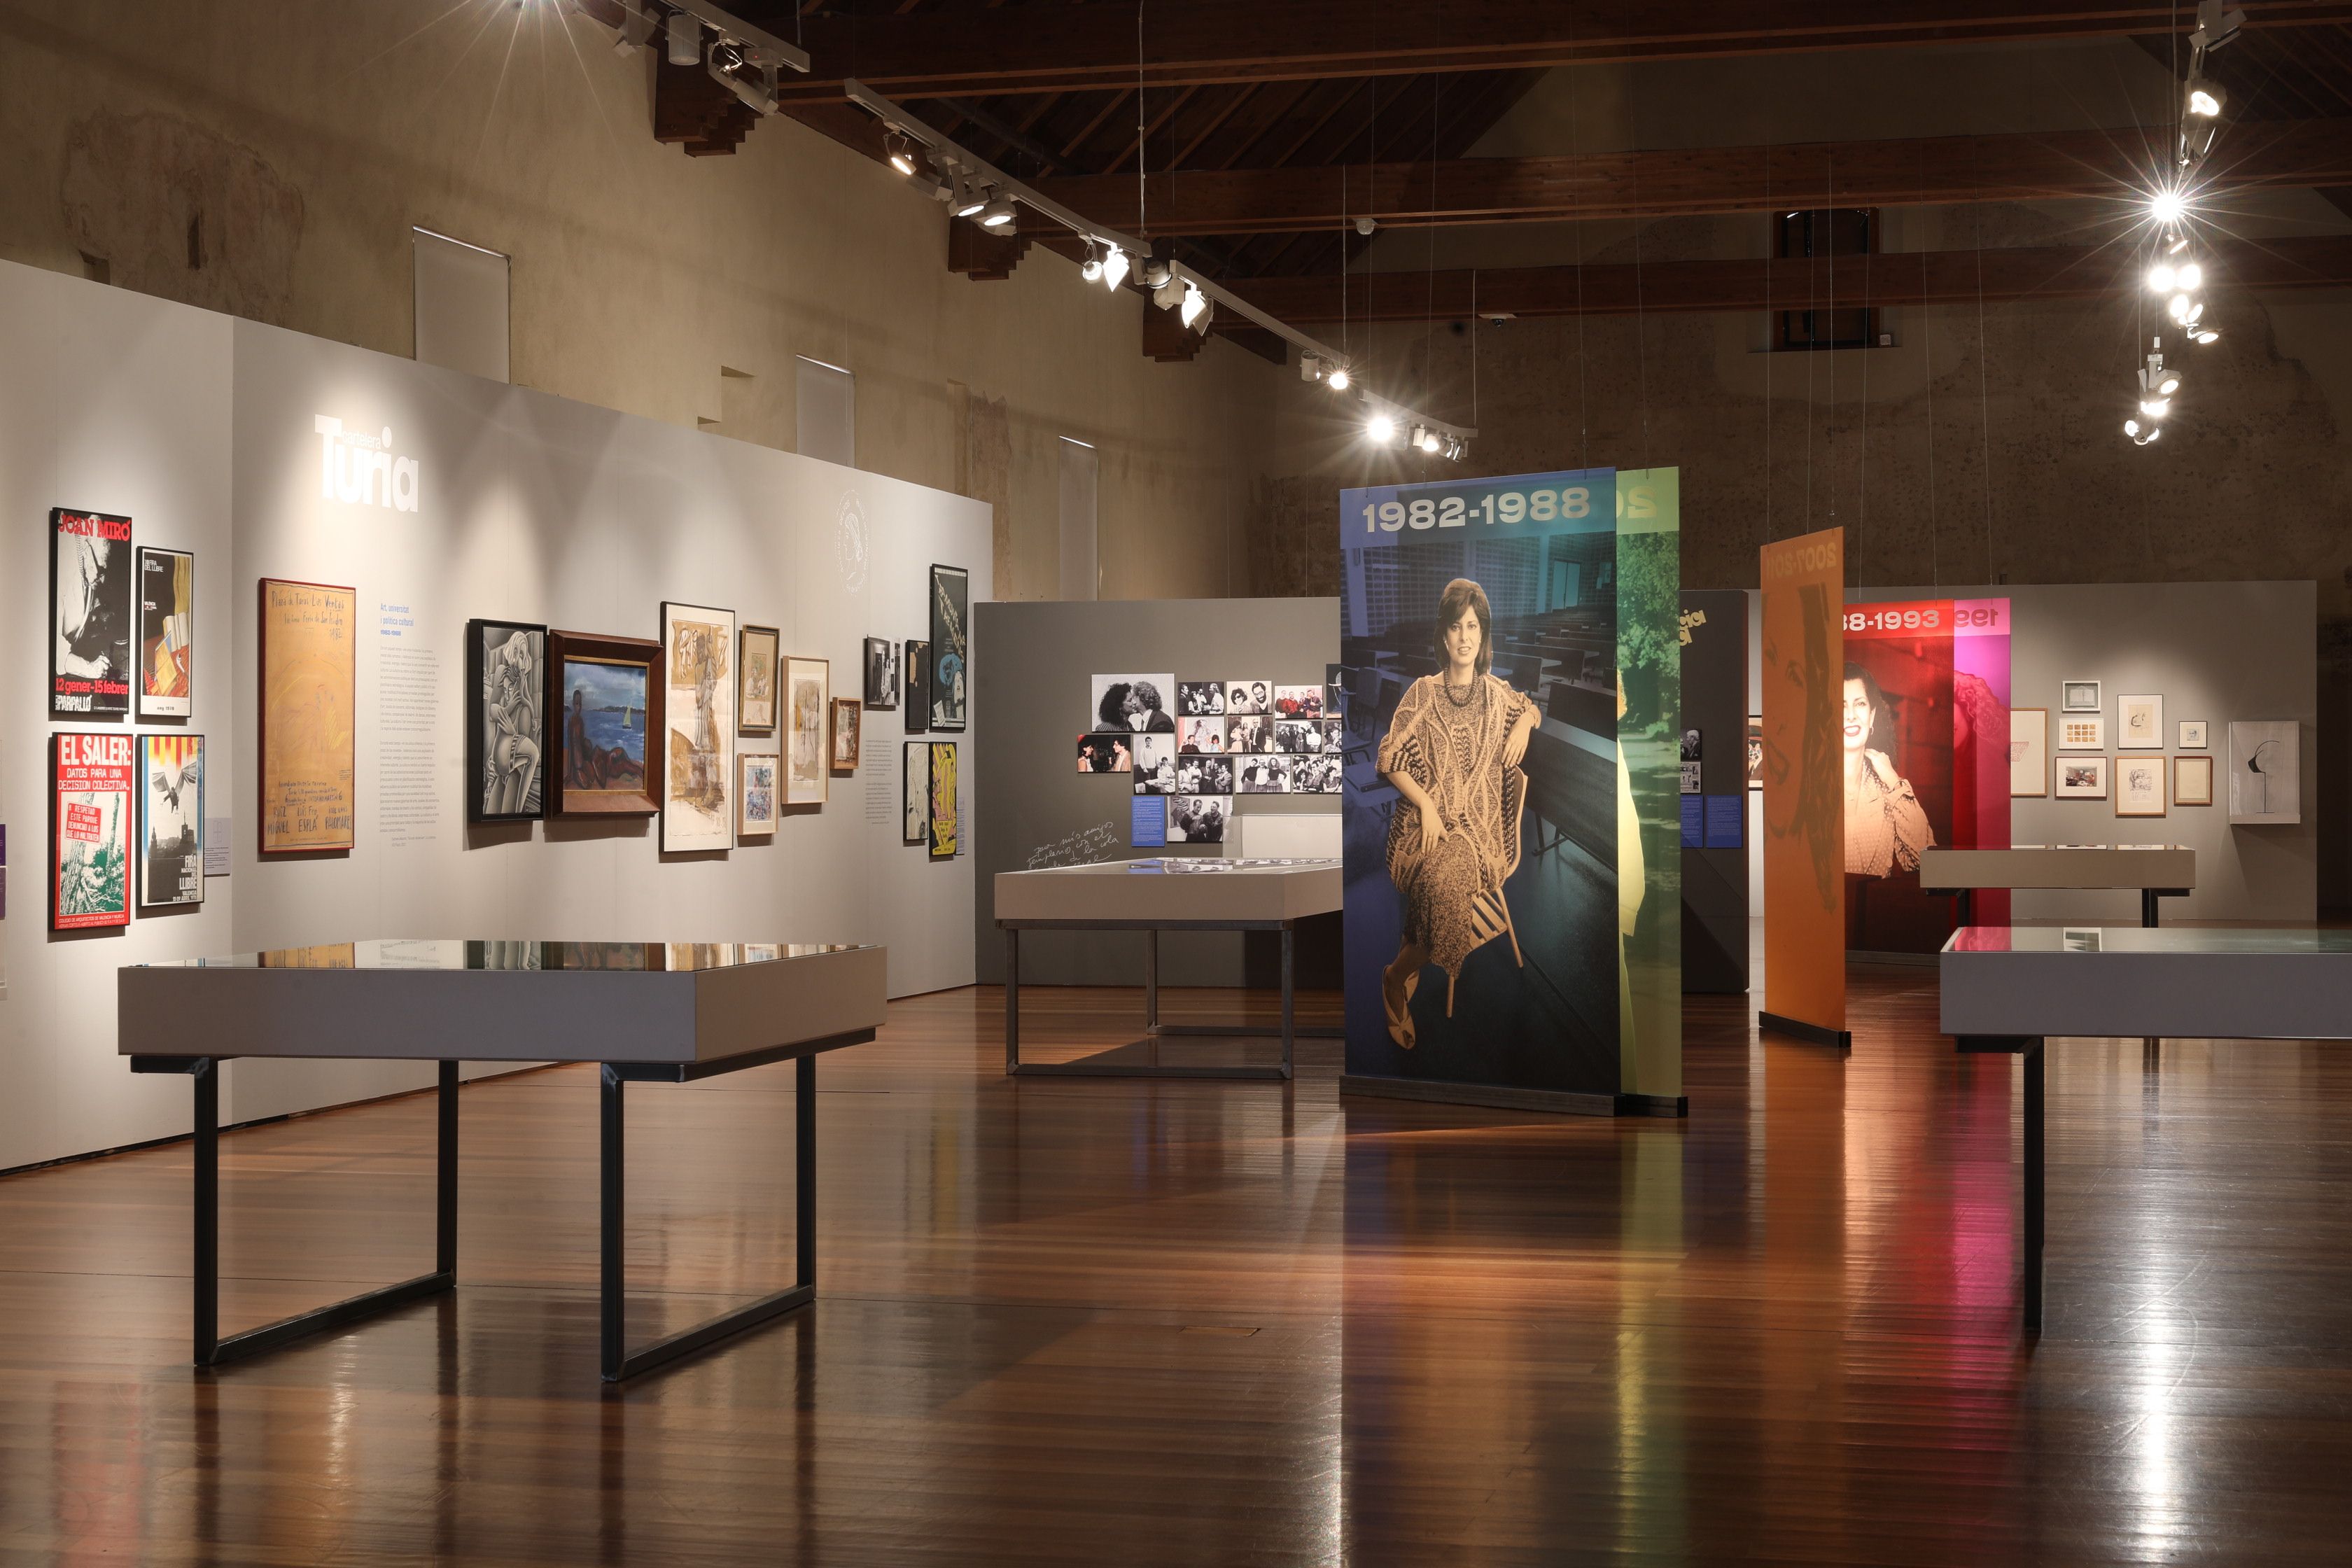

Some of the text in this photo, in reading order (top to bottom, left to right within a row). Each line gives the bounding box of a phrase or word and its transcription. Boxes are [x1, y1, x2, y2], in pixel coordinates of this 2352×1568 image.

[342, 431, 382, 449] cartelera
[315, 414, 419, 512] Turia
[1362, 486, 1590, 533] 1982-1988
[58, 514, 131, 542] JOAN MIRÓ
[56, 678, 64, 692] 12
[61, 736, 131, 766] EL SALER:
[66, 768, 122, 778] DATOS PARA UNA
[58, 780, 90, 790] DECISION
[71, 813, 98, 825] ESTE PARQUE
[185, 855, 197, 867] FIRA
[179, 877, 197, 890] LLIBRE
